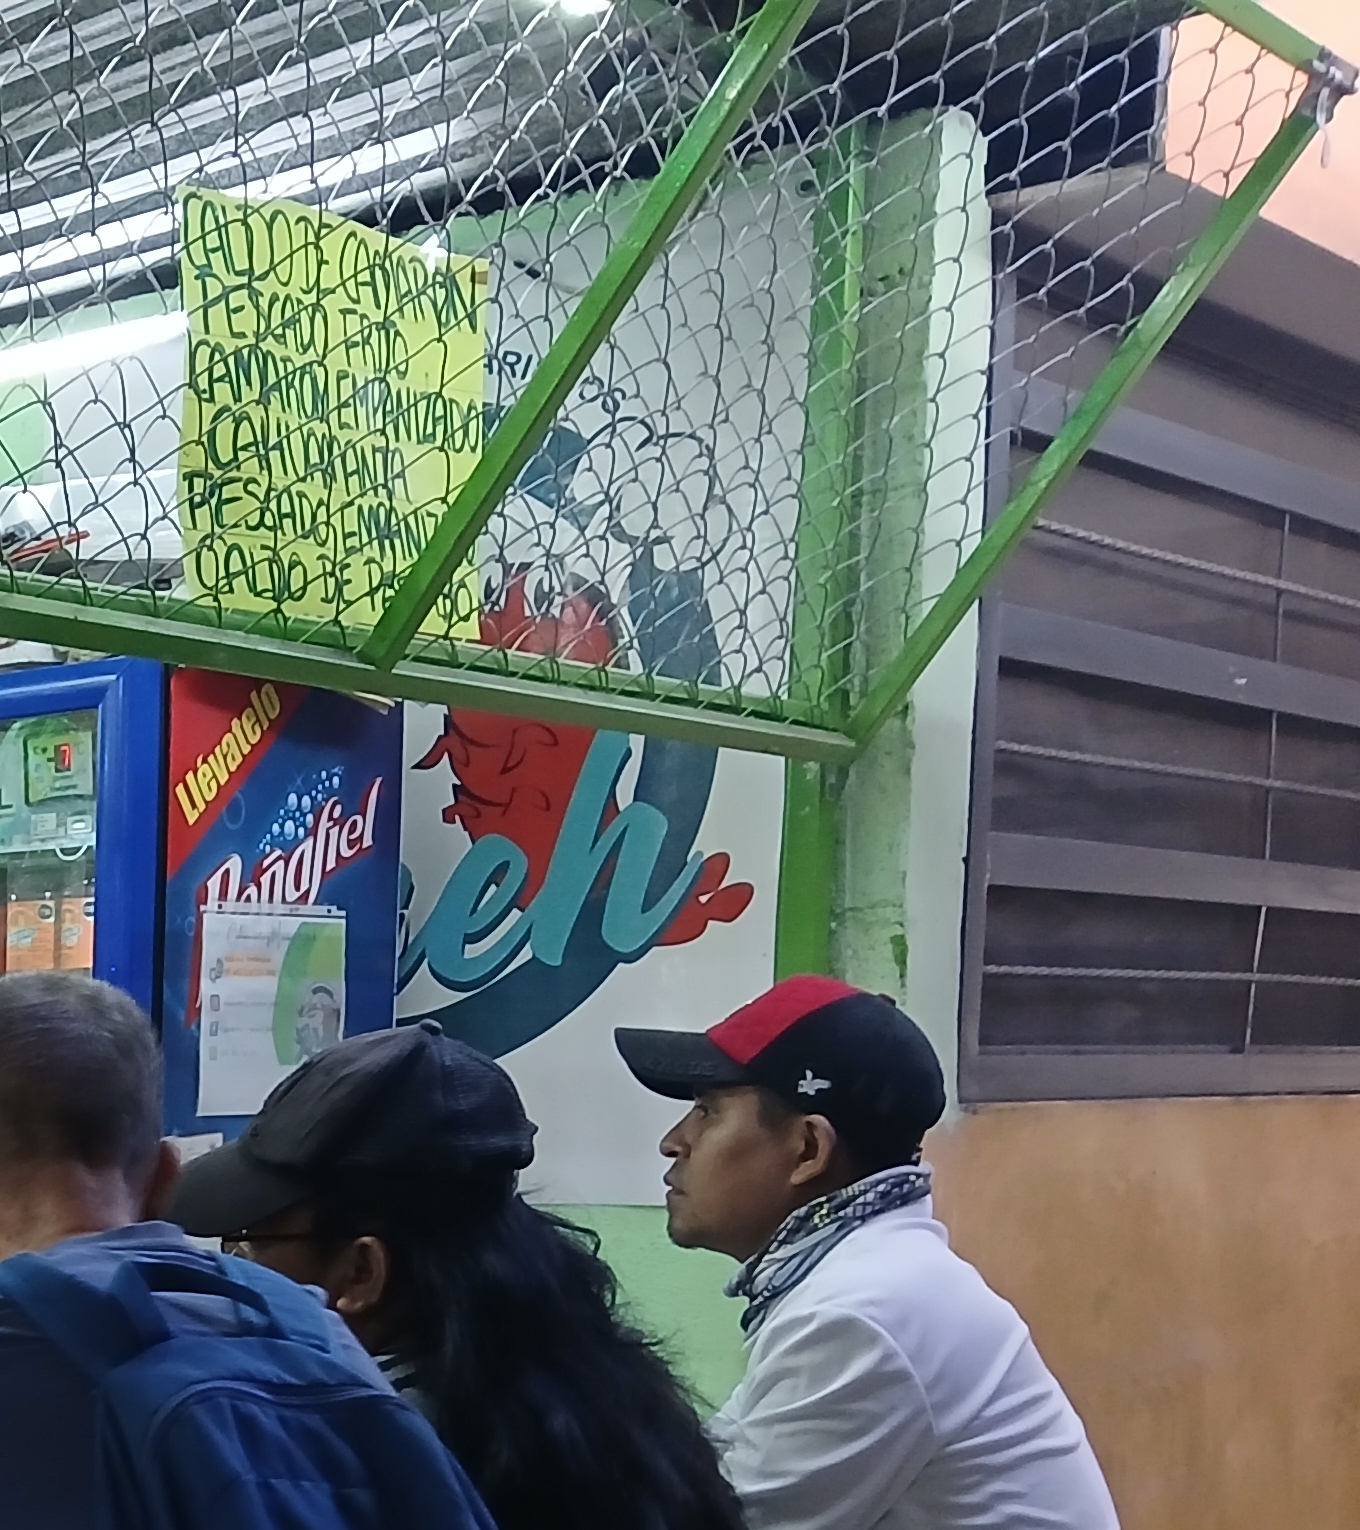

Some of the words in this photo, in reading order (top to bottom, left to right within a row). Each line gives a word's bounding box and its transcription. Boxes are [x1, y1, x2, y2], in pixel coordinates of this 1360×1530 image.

[183, 191, 294, 287] CALDO
[294, 215, 336, 299] DE
[316, 553, 353, 606] DE
[175, 682, 281, 826] Llévatelo
